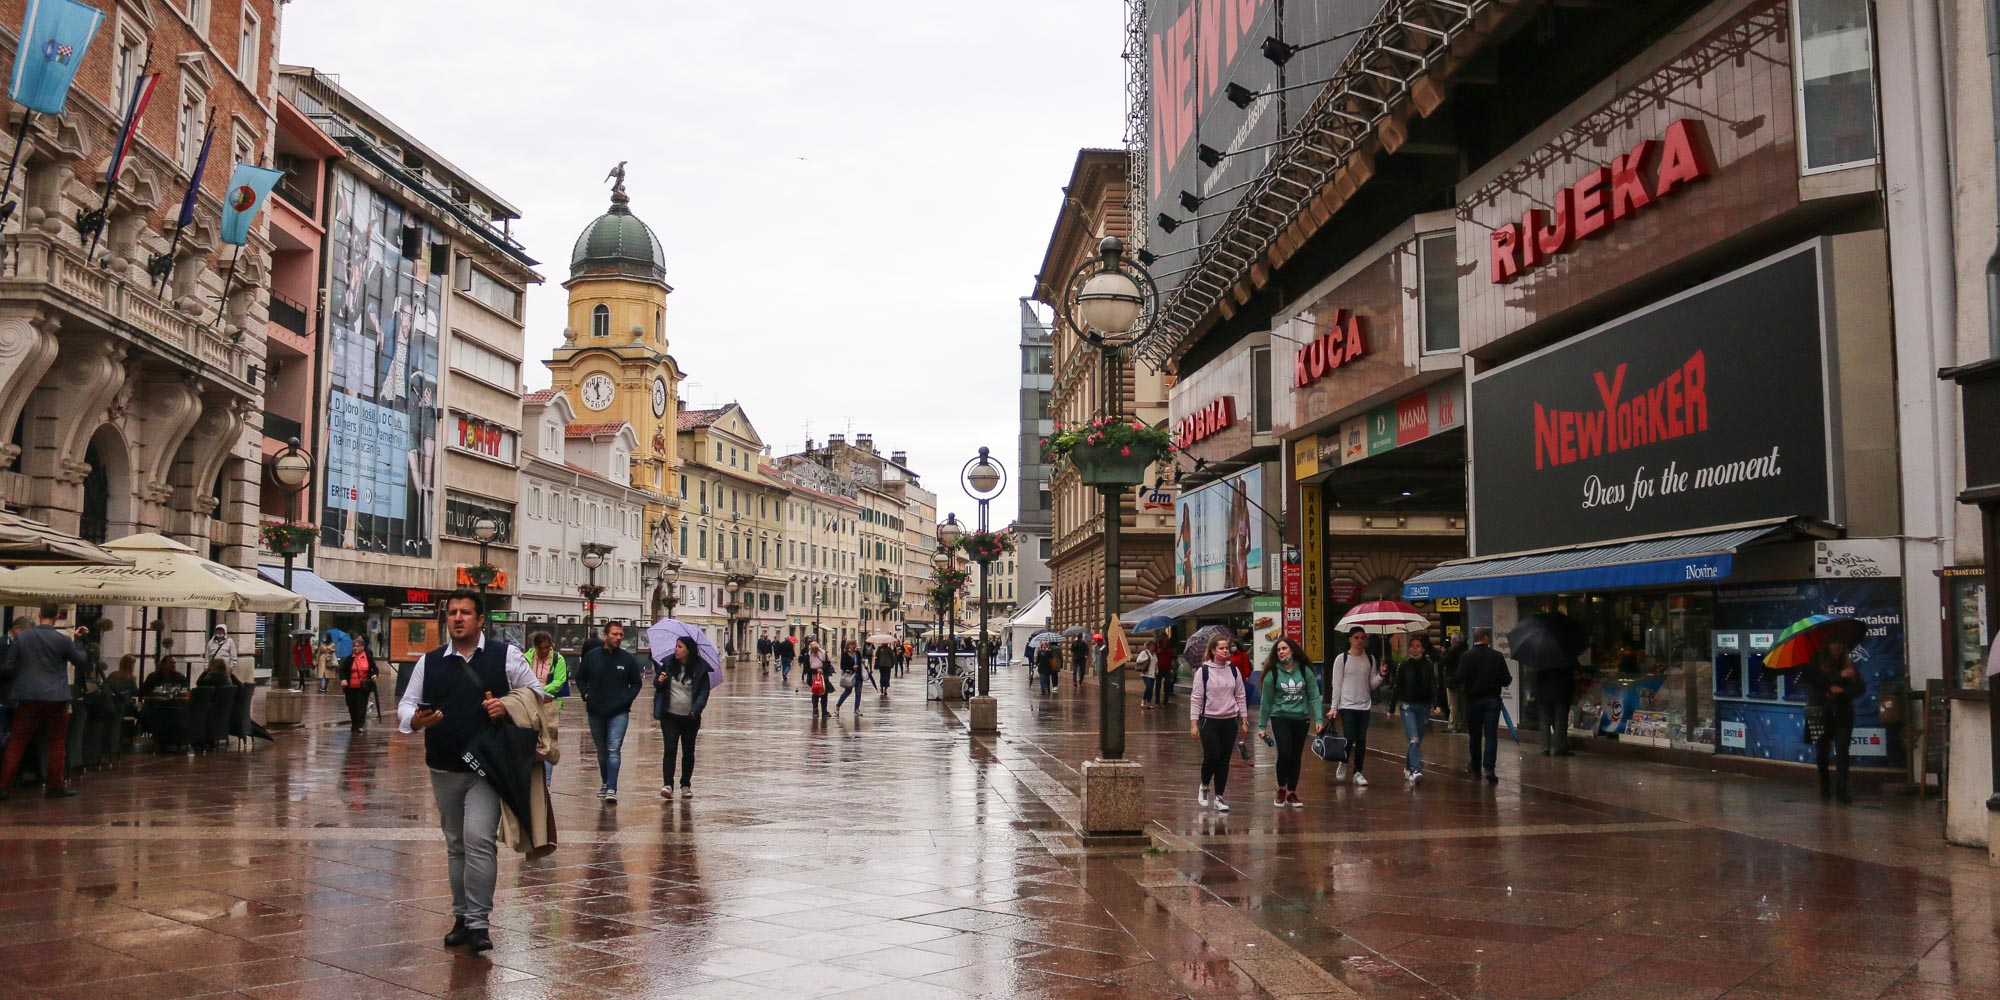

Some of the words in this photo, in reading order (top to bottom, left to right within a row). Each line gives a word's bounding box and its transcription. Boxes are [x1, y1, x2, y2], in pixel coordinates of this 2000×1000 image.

[1489, 118, 1702, 284] RIJEKA
[1294, 308, 1363, 388] KUĆA
[1176, 396, 1232, 448] ROBNA
[1399, 405, 1427, 432] MANA
[1349, 424, 1361, 446] dm
[1582, 475, 1625, 509] Dress
[1625, 466, 1655, 511] for
[1660, 461, 1689, 495] the
[1694, 445, 1782, 489] moment.
[331, 484, 350, 500] ERTE
[1149, 488, 1171, 503] dm
[1685, 563, 1718, 580] iNovine
[1952, 568, 1985, 576] TRANSVERZ
[1309, 561, 1317, 610] HOME
[74, 592, 110, 601] NATURAL
[112, 594, 147, 602] MINERAL
[149, 595, 176, 603] WATER
[1828, 605, 1855, 614] Erste
[1723, 729, 1738, 738] ERSTE
[1851, 736, 1868, 745] STE
